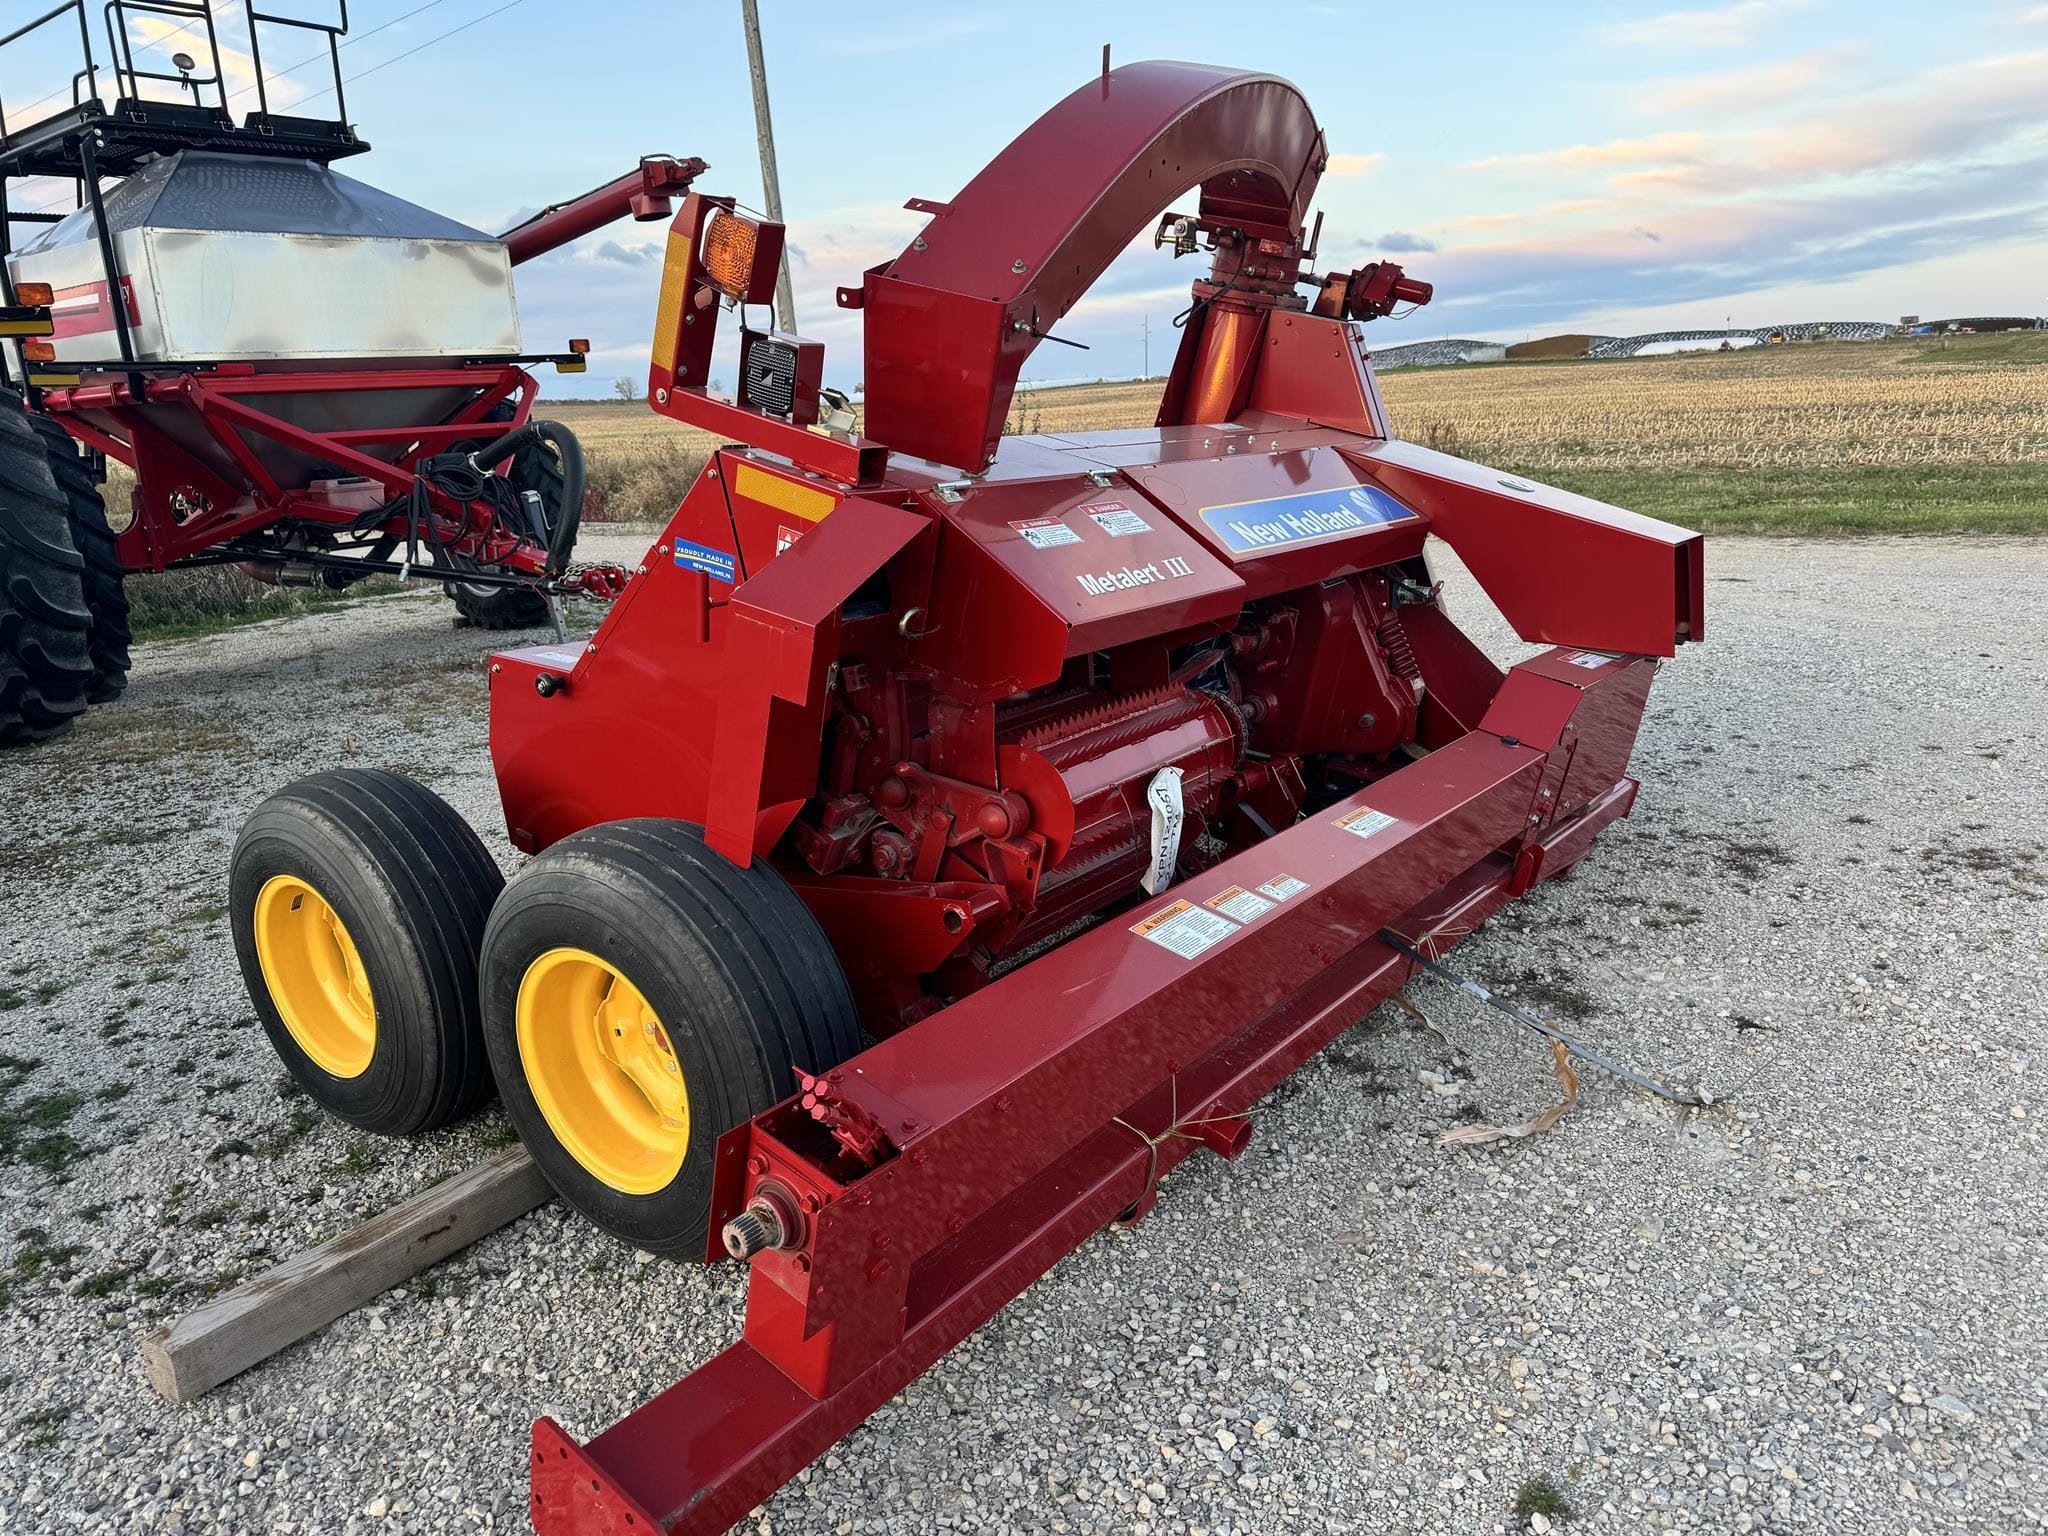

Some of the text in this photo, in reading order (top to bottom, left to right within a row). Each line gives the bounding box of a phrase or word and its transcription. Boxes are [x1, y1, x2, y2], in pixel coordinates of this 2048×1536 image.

[1095, 504, 1123, 512] DANGER
[1028, 519, 1051, 527] DANGER
[1227, 504, 1365, 546] New Holland
[676, 547, 704, 558] PROUDLY
[706, 553, 724, 563] MADE
[693, 562, 704, 570] NEW
[1076, 556, 1196, 597] Metalert III
[1153, 905, 1183, 925] WARNING
